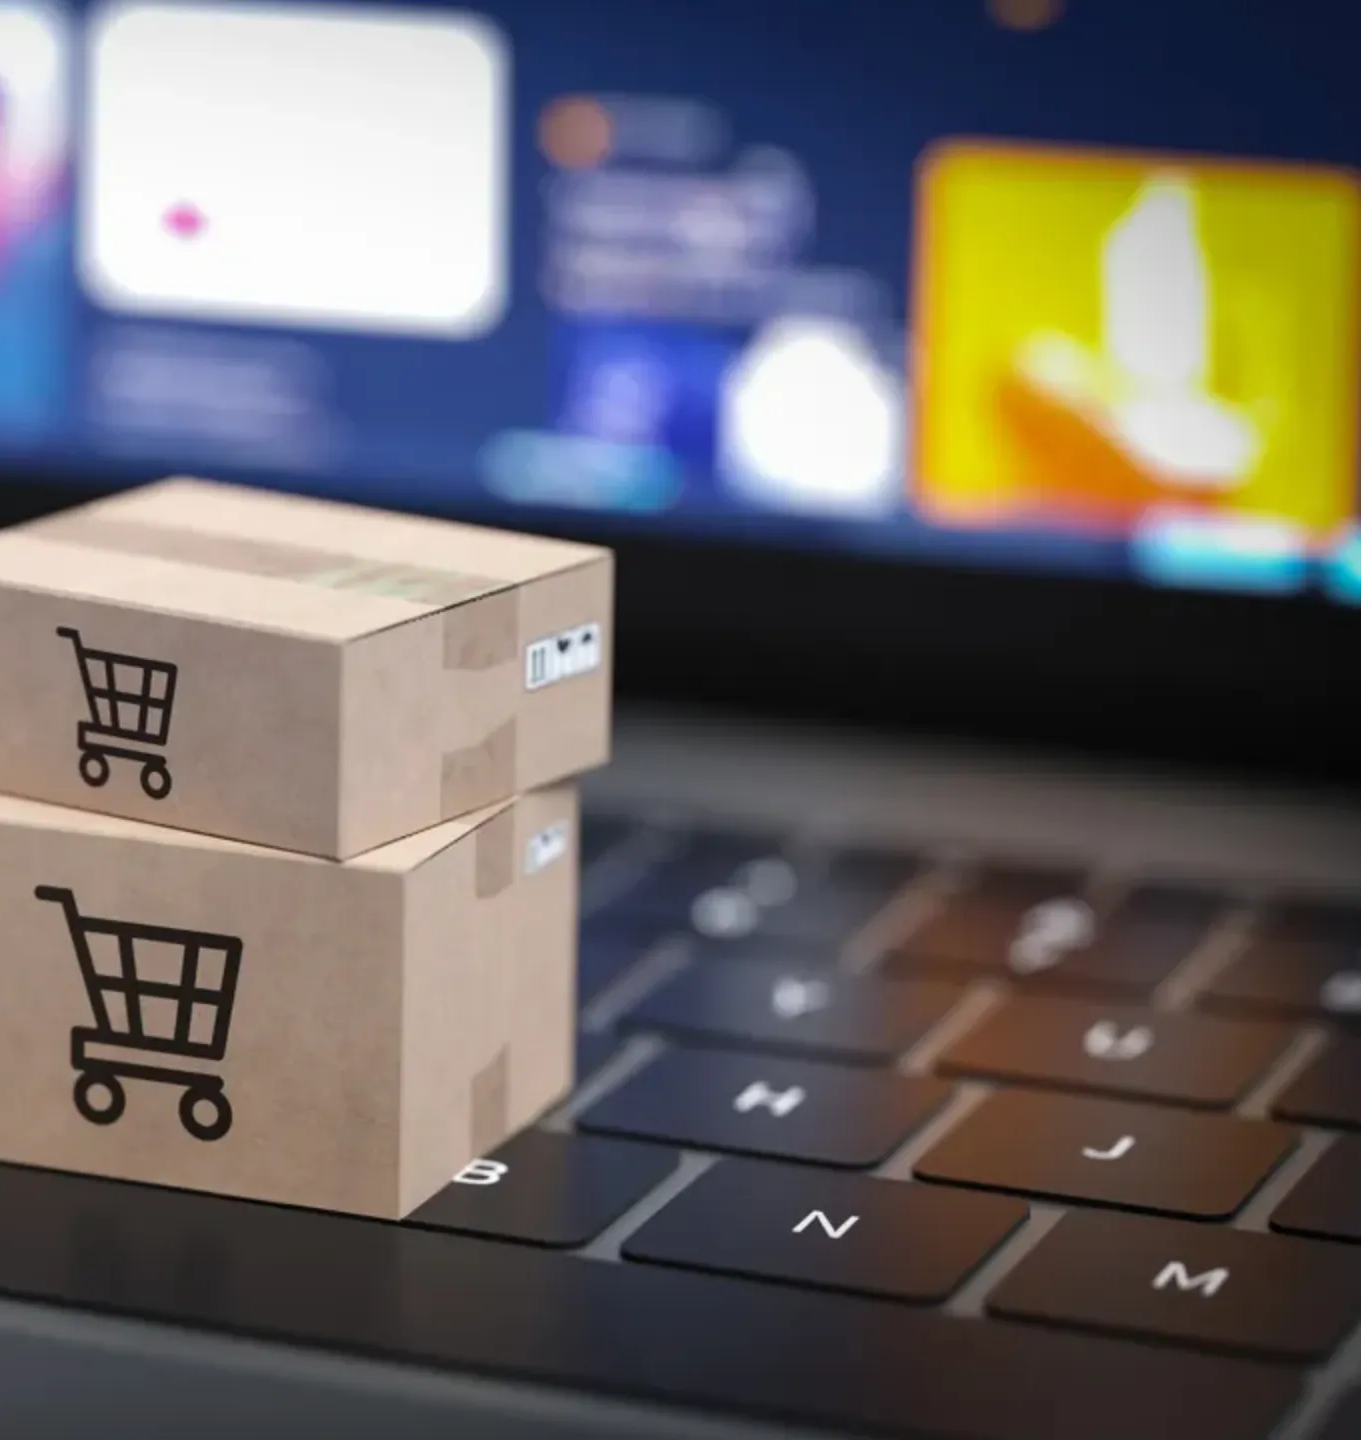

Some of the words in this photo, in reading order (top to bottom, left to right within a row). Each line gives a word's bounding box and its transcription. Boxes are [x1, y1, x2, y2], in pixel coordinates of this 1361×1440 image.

[734, 1080, 805, 1116] H
[1082, 1135, 1135, 1160] J
[453, 1158, 509, 1185] B
[792, 1210, 859, 1238] N
[1152, 1260, 1229, 1297] M
